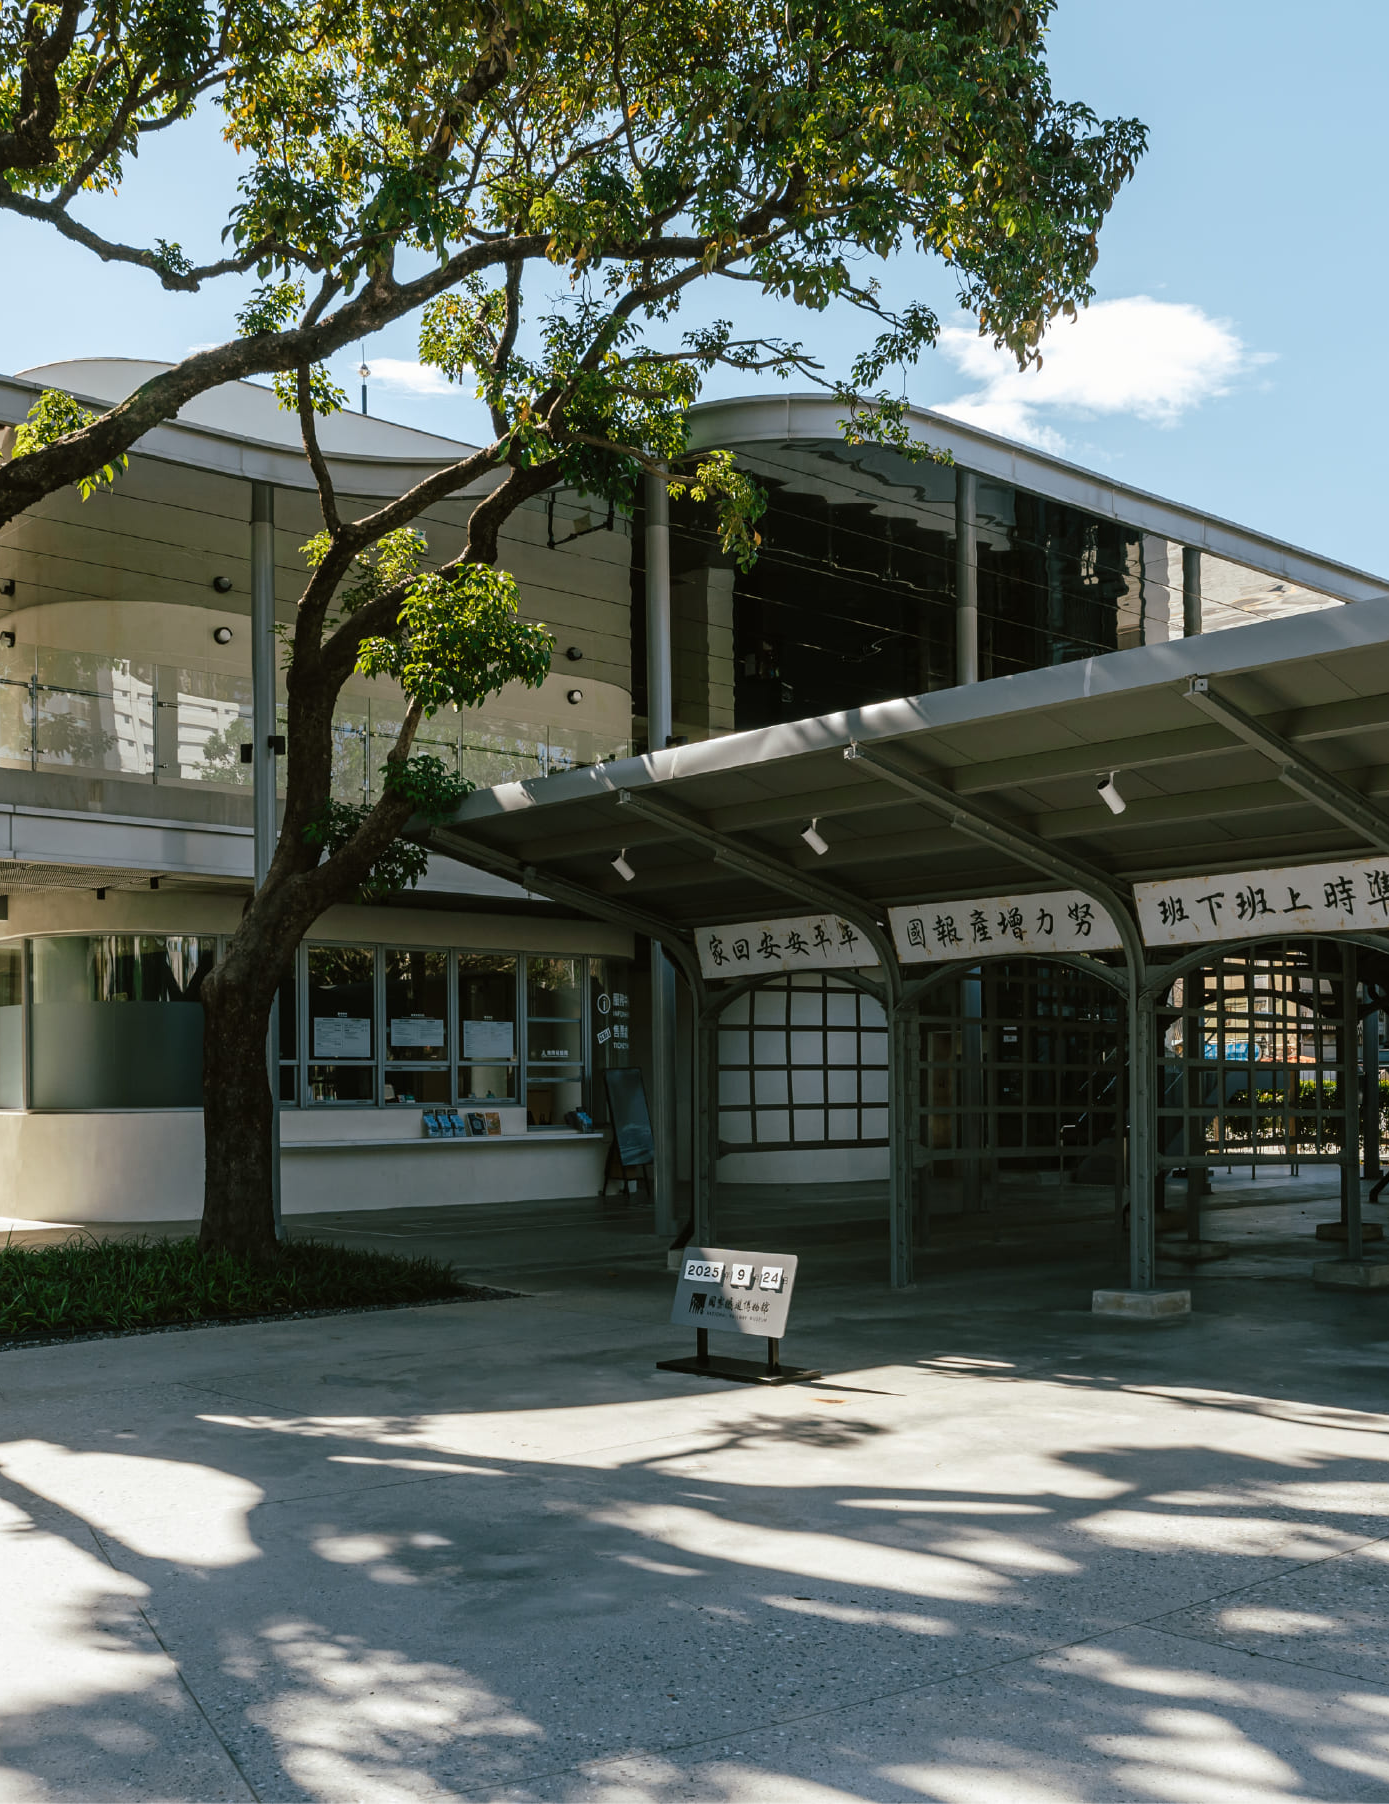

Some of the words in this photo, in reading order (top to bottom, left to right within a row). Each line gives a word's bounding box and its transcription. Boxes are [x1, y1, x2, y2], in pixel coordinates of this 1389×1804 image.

[687, 1265, 719, 1278] 2025
[737, 1269, 746, 1281] 9
[762, 1271, 779, 1284] 24
